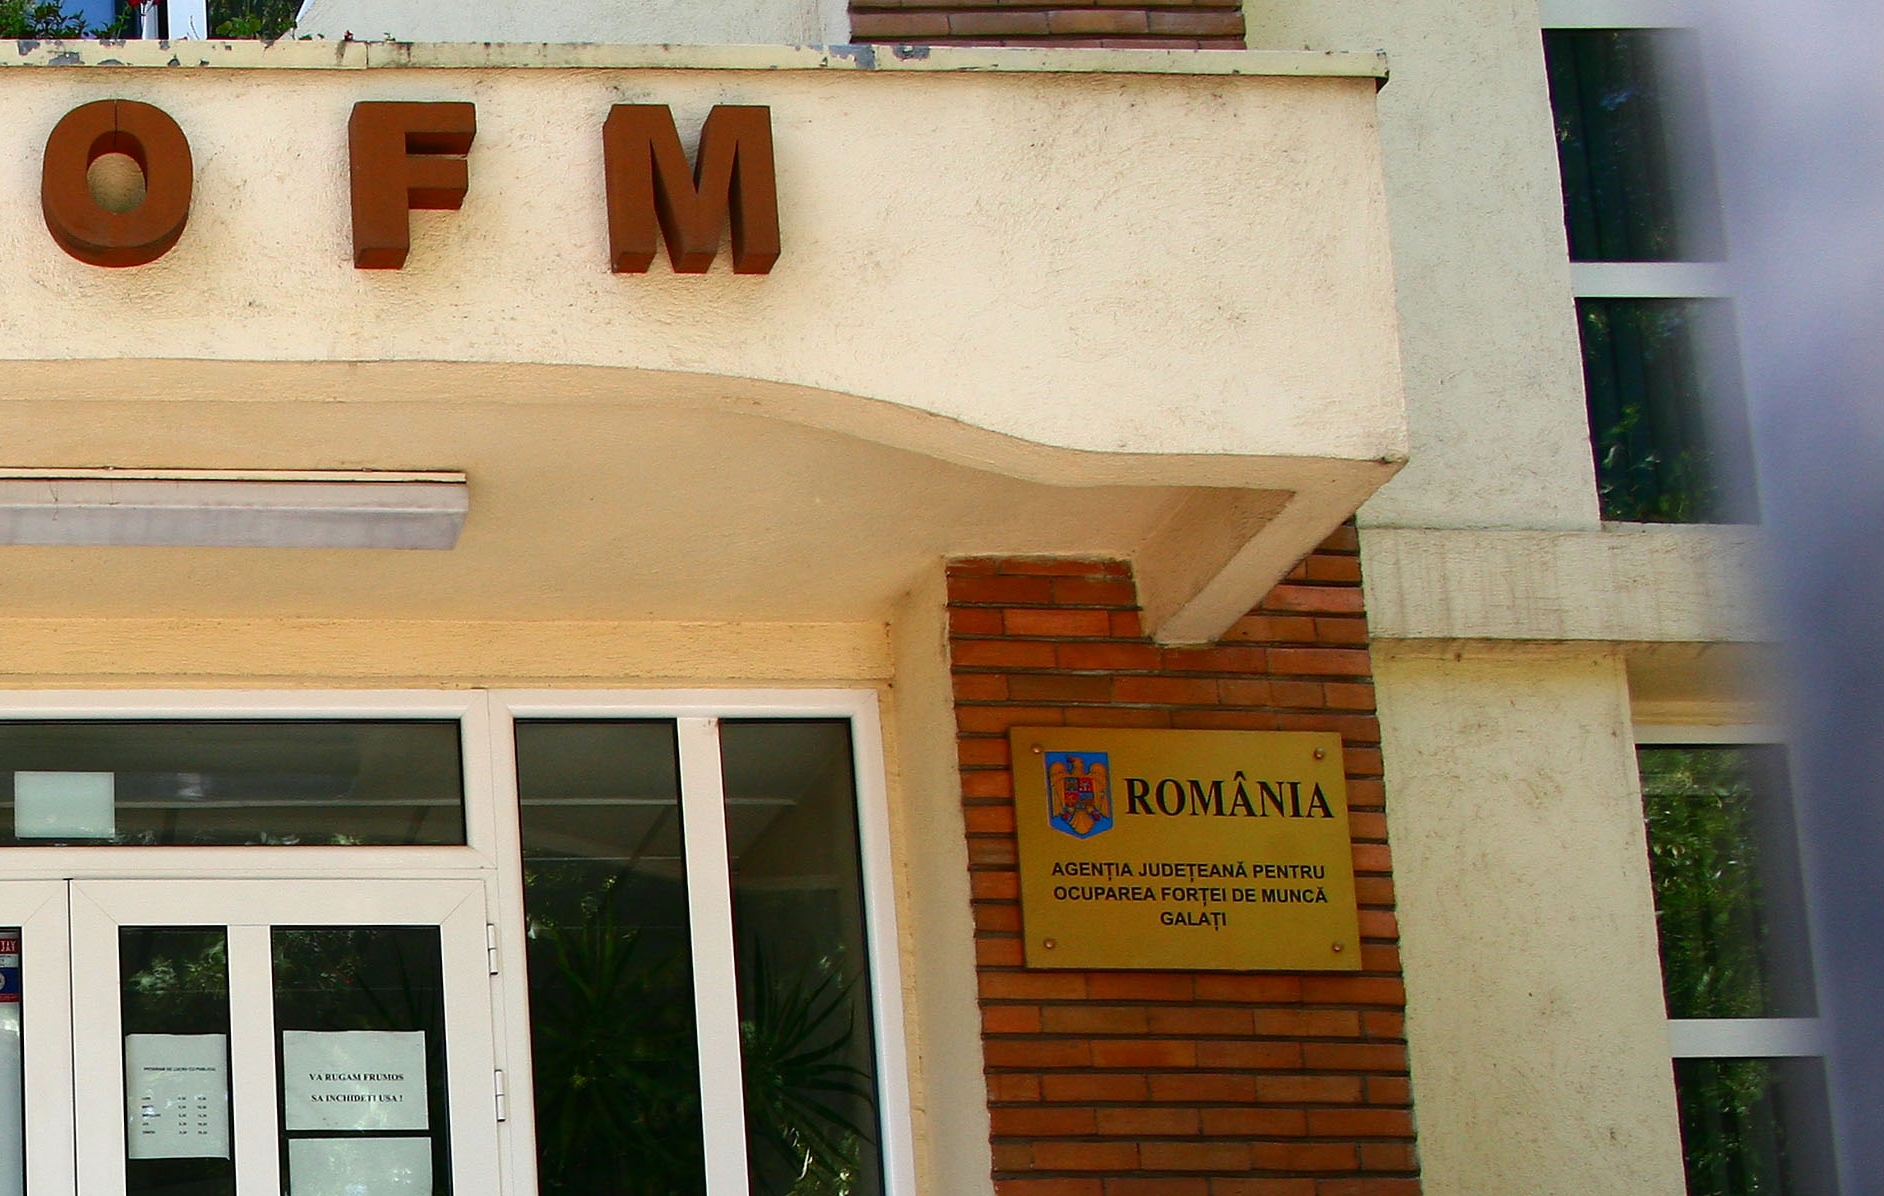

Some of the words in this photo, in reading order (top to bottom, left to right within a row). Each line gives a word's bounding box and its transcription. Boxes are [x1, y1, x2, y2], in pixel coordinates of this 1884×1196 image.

[1124, 771, 1334, 818] ROMÂNIA
[1052, 862, 1133, 881] AGENȚIA
[1138, 861, 1247, 882] JUDEȚEANĂ
[1253, 864, 1325, 879] PENTRU
[1053, 886, 1156, 901] OCUPAREA
[1161, 887, 1226, 906] FORȚEI
[1232, 888, 1256, 902] DE
[1261, 886, 1328, 903] MUNCĂ
[1160, 911, 1227, 931] GALAȚI
[309, 1073, 323, 1081] VA
[325, 1073, 361, 1081] RUGAM
[363, 1073, 404, 1081] FRUMOS
[311, 1094, 323, 1102] SA
